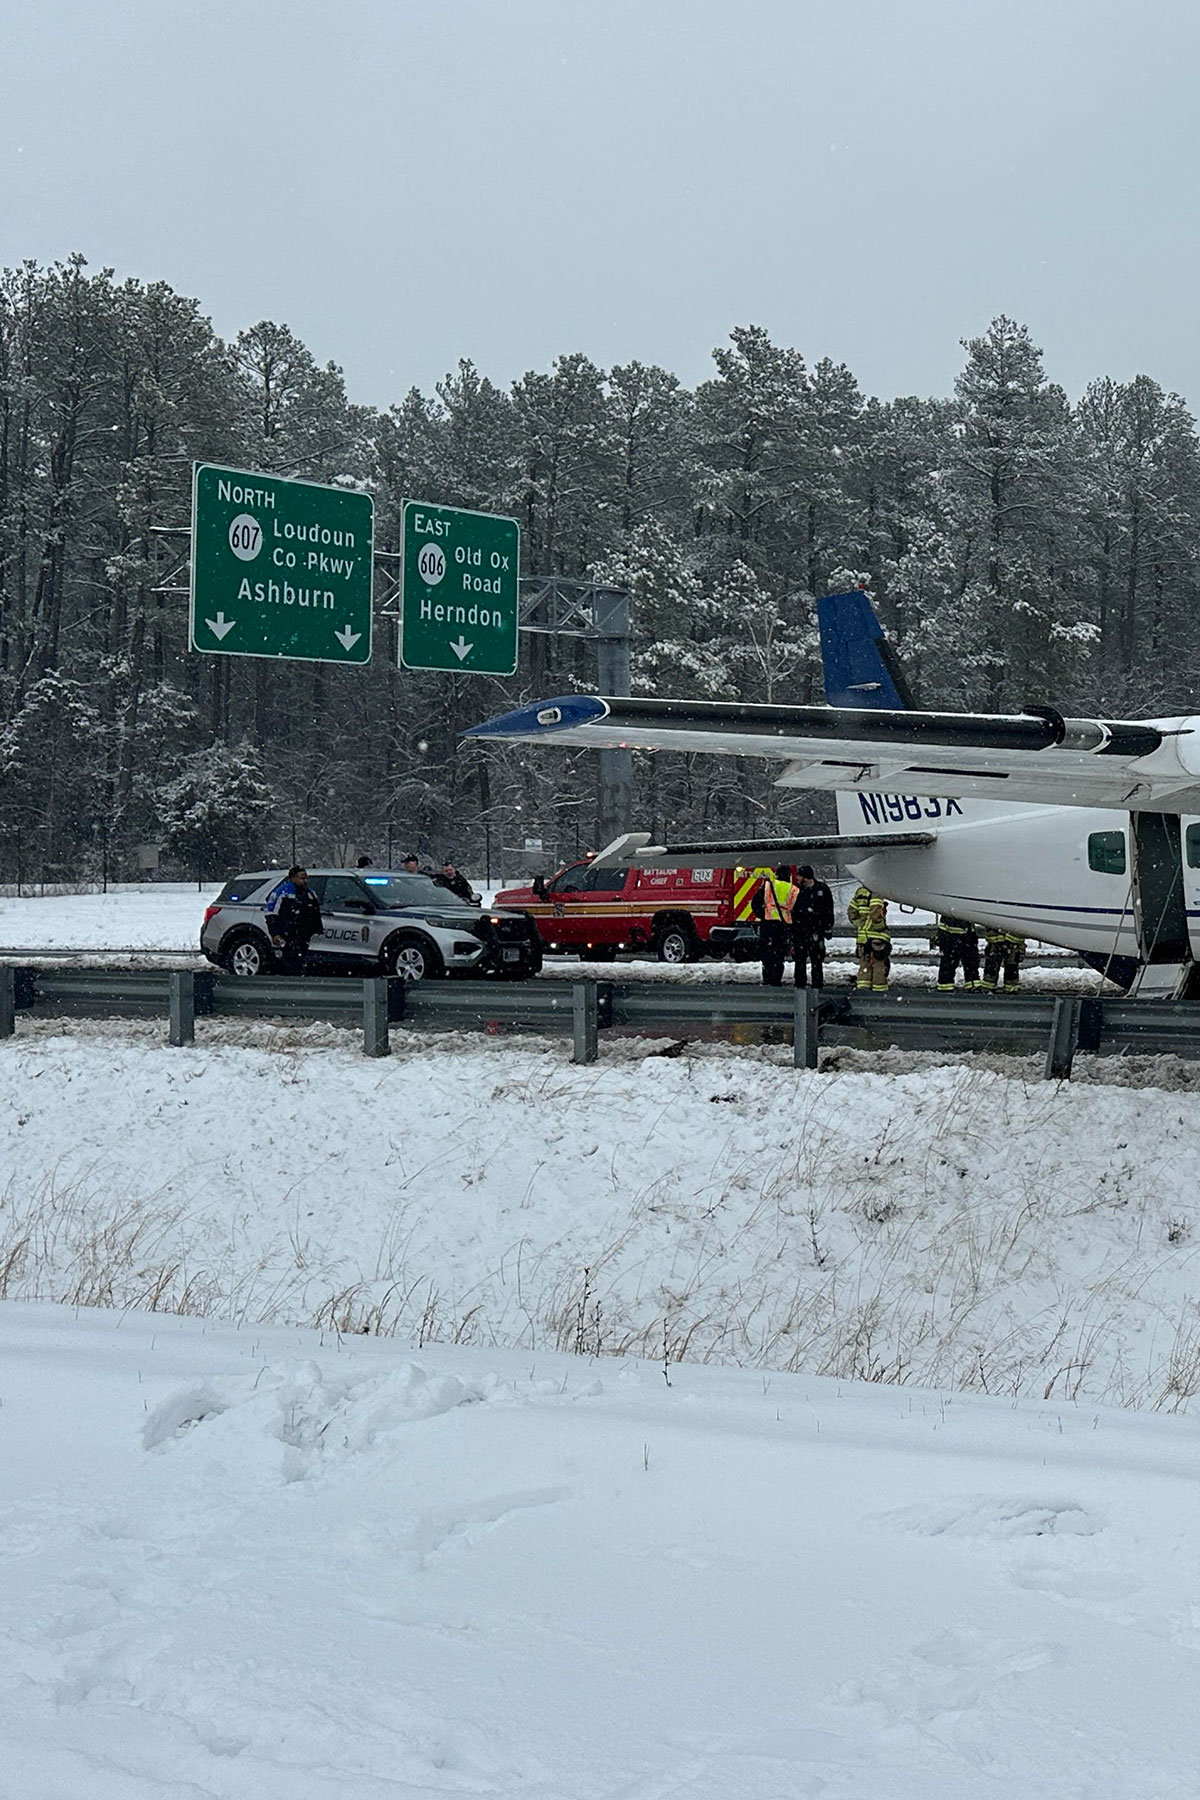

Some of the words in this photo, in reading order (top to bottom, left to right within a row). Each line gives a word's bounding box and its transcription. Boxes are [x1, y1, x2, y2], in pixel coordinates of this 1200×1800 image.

[218, 479, 276, 509] NORTH
[231, 524, 260, 551] 607
[273, 518, 355, 548] Loudoun
[414, 513, 451, 537] EAST
[273, 547, 297, 568] Co
[307, 552, 354, 580] Pkwy
[420, 552, 444, 577] 606
[454, 546, 482, 566] Old
[490, 552, 509, 570] Ox
[237, 577, 335, 610] Ashburn
[462, 573, 502, 594] Road
[419, 599, 502, 628] Herndon
[693, 868, 712, 882] 603
